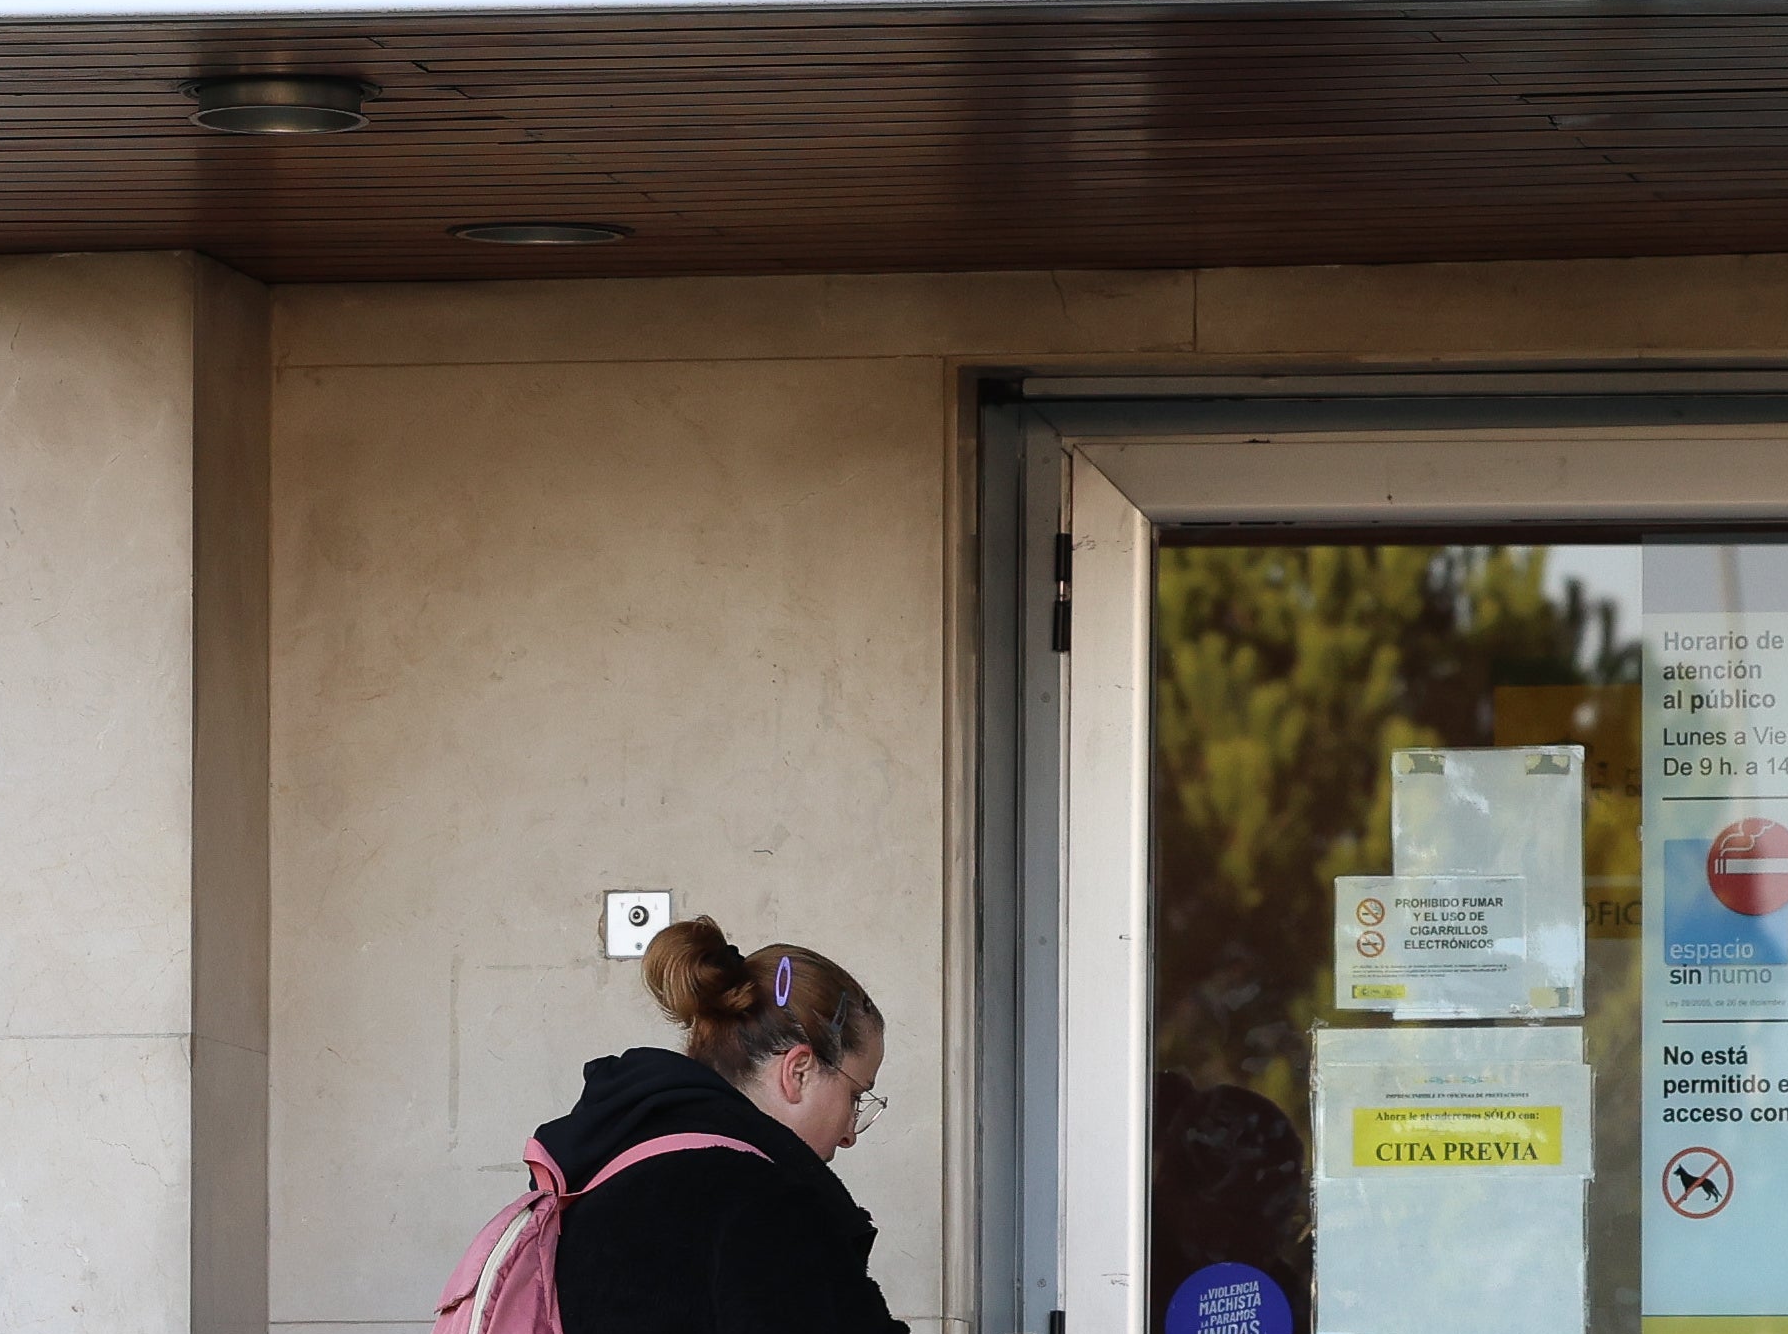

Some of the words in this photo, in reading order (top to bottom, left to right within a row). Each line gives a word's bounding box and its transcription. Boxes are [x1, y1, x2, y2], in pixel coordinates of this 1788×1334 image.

[1664, 631, 1748, 651] Horario
[1757, 630, 1784, 649] de
[1663, 660, 1762, 680] atención
[1663, 690, 1682, 709] al
[1691, 688, 1776, 714] público
[1663, 728, 1727, 746] Lunes
[1734, 731, 1746, 745] a
[1663, 758, 1692, 776] De
[1700, 758, 1712, 776] 9
[1720, 757, 1738, 776] h.
[1746, 761, 1758, 775] a
[1395, 898, 1459, 908] PROHIBIDO
[1462, 897, 1503, 907] FUMAR
[1414, 912, 1421, 921] Y
[1424, 912, 1438, 921] EL
[1441, 912, 1465, 921] USO
[1470, 911, 1485, 921] DE
[1410, 925, 1488, 936] CIGARRILLOS
[1404, 937, 1494, 950] ELECTRÓNICOS
[1670, 938, 1754, 964] espacio
[1669, 964, 1702, 984] sin
[1708, 967, 1772, 984] humo
[1663, 1046, 1694, 1065] No
[1701, 1045, 1748, 1065] está
[1663, 1074, 1770, 1098] permitido
[1375, 1112, 1407, 1121] Ahora
[1409, 1112, 1419, 1121] le
[1484, 1109, 1516, 1121] SÓLO
[1663, 1107, 1742, 1123] acceso
[1375, 1142, 1436, 1161] CITA
[1443, 1142, 1538, 1161] PREVIA
[1208, 1280, 1259, 1299] VIOLENCIA
[1199, 1292, 1261, 1316] MACHISTA
[1210, 1308, 1256, 1326] PARAMOS
